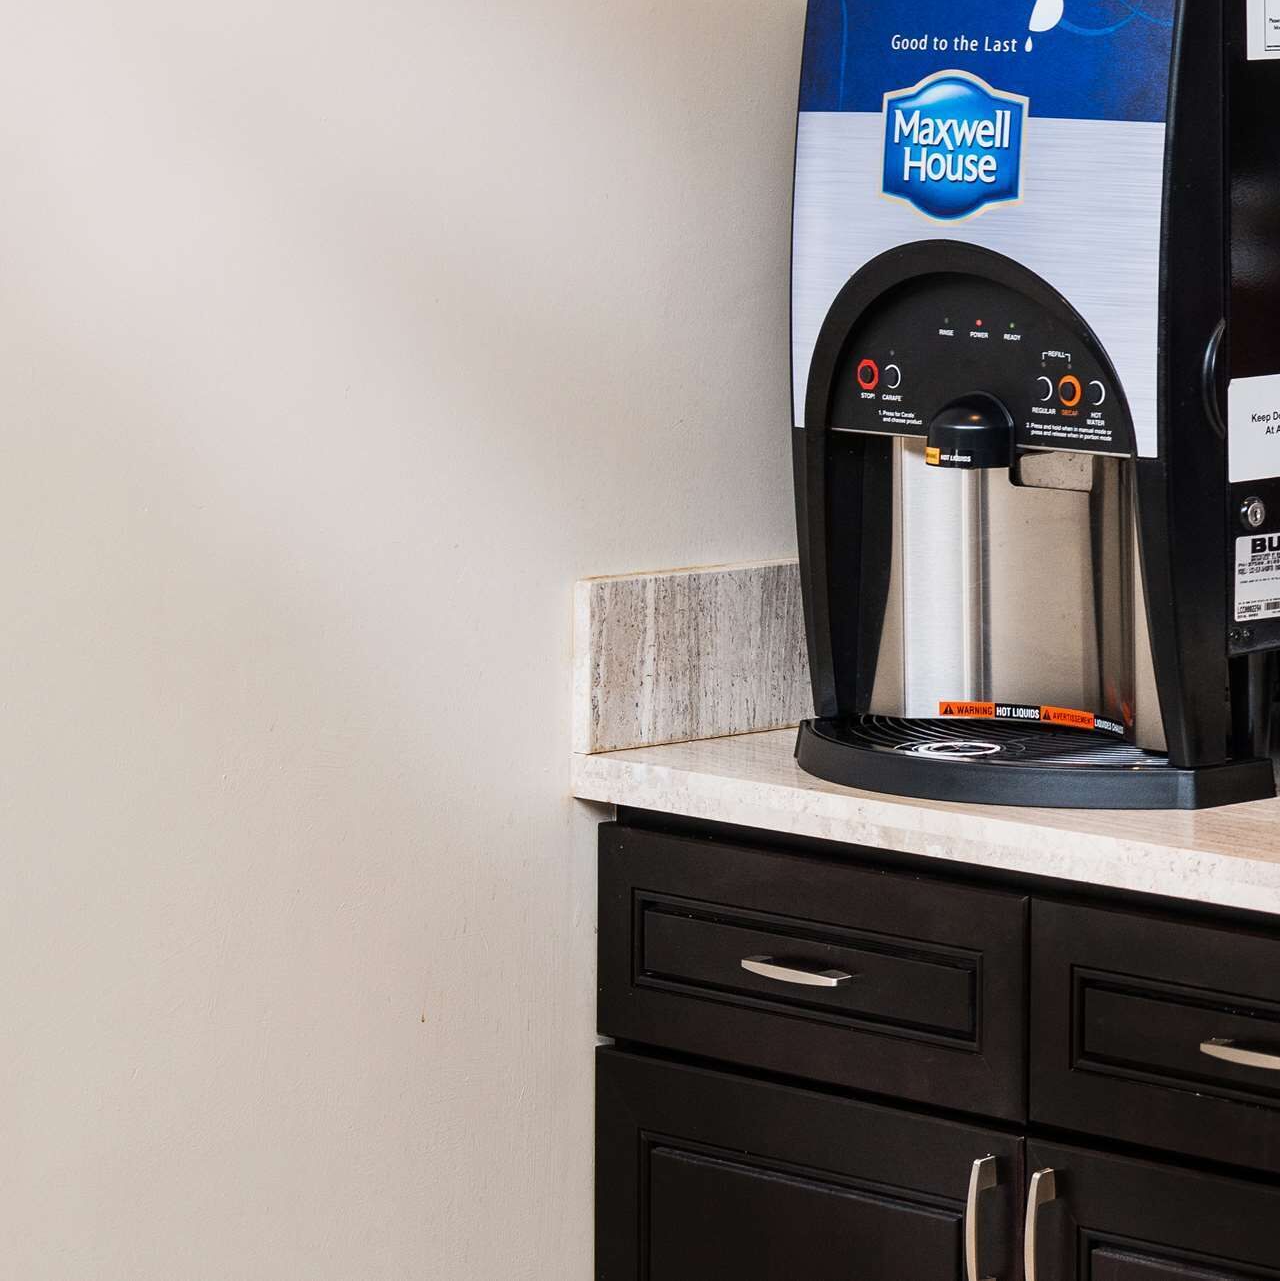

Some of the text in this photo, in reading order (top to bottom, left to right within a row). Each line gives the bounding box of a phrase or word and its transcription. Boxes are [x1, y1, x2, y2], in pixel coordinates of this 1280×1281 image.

[892, 35, 1017, 52] Good to the Last
[894, 109, 1011, 151] Maxwell
[903, 147, 997, 183] House
[970, 331, 989, 339] POWER
[1252, 413, 1271, 423] Keep
[1266, 426, 1274, 435] At
[957, 706, 993, 717] WARNING
[996, 706, 1040, 719] HOT LIQUIDS
[1053, 711, 1093, 725] AVERTISSEMENT
[1094, 718, 1111, 731] LIQUIDES
